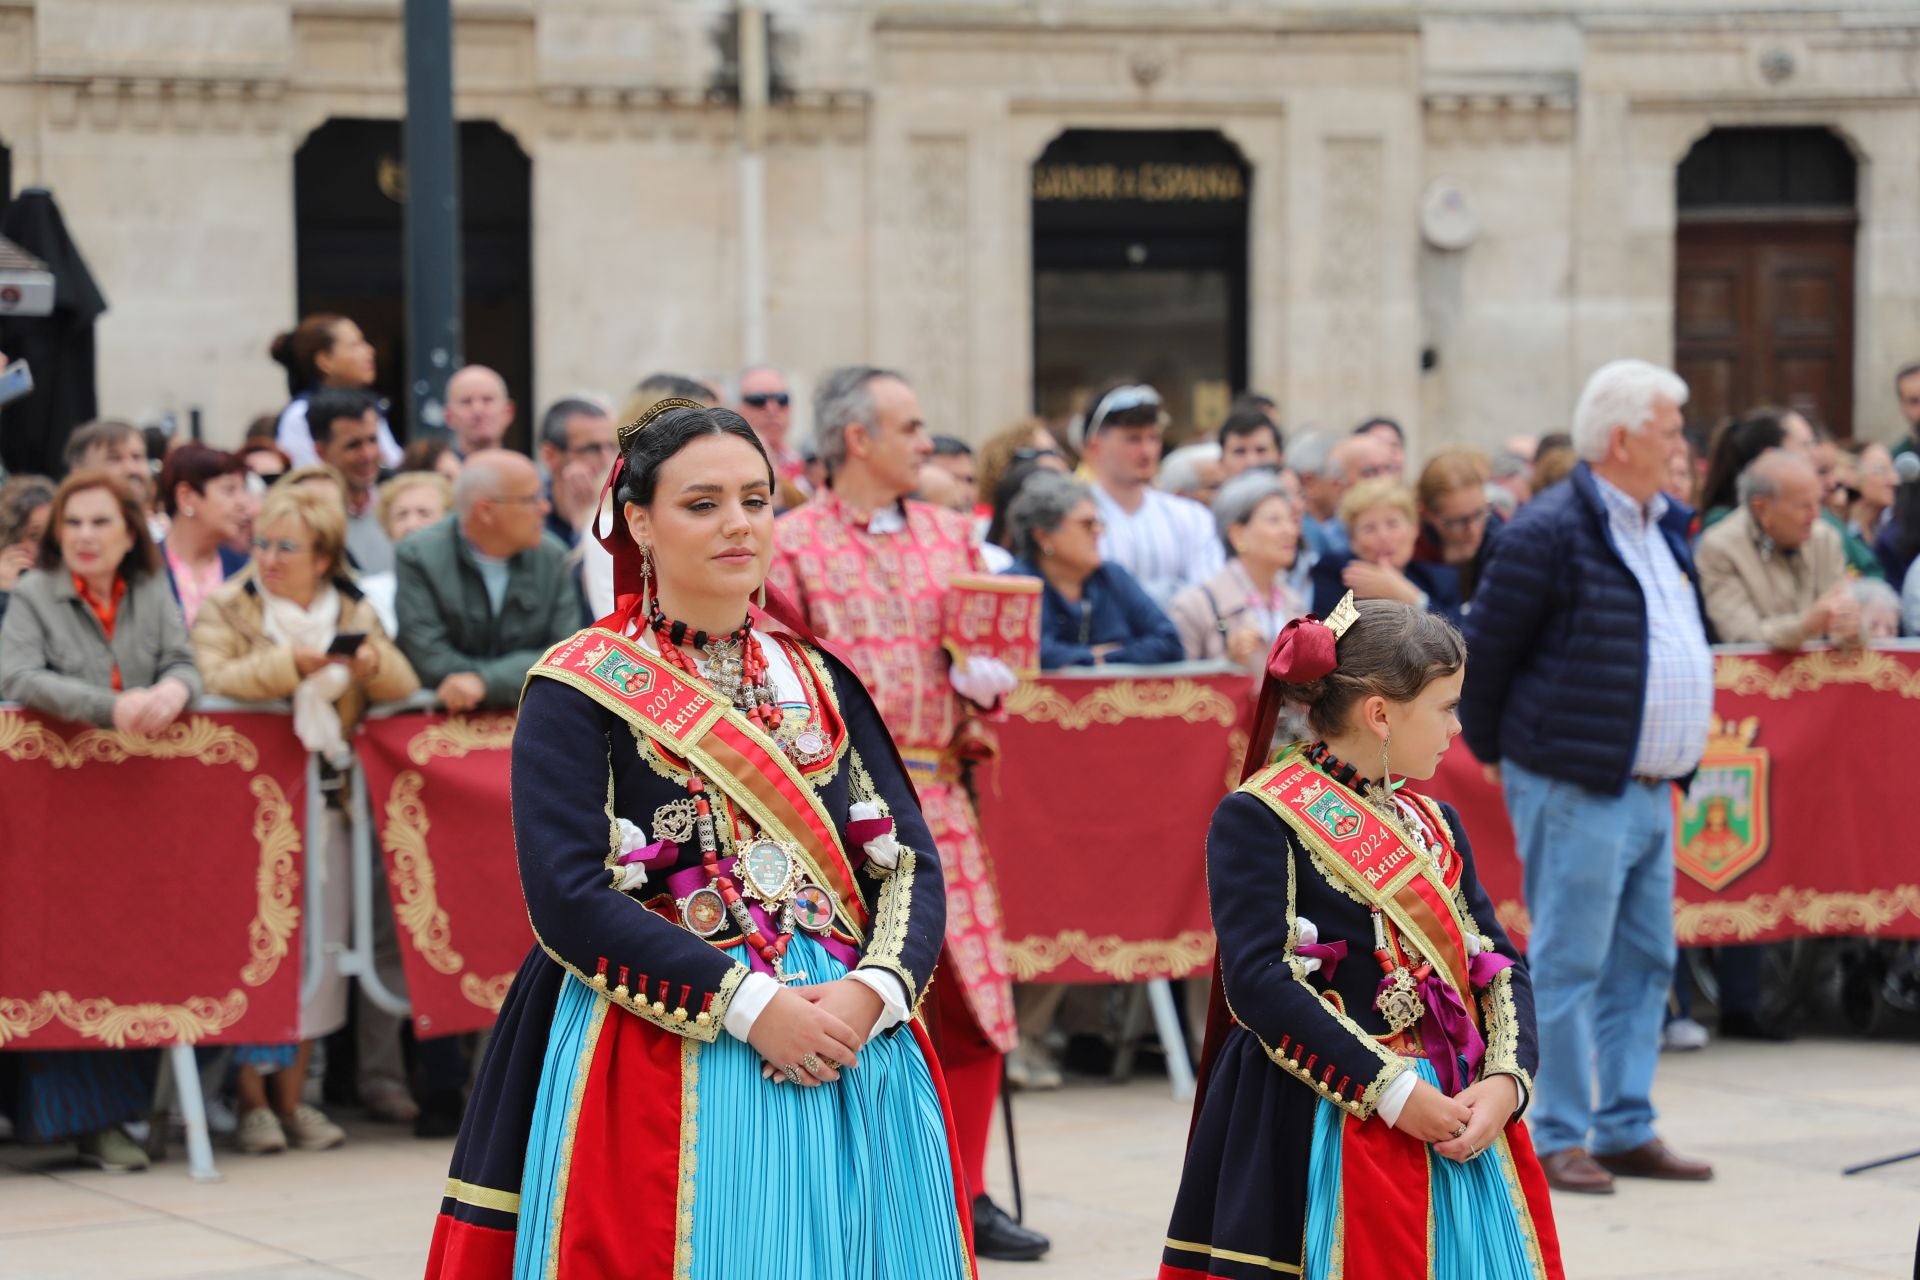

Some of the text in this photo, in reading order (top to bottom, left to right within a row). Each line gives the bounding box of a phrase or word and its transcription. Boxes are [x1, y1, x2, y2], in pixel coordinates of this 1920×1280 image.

[646, 679, 684, 720] 2024
[661, 694, 708, 735] Reina
[1351, 826, 1390, 866] 2024
[1362, 845, 1409, 885] Reina
